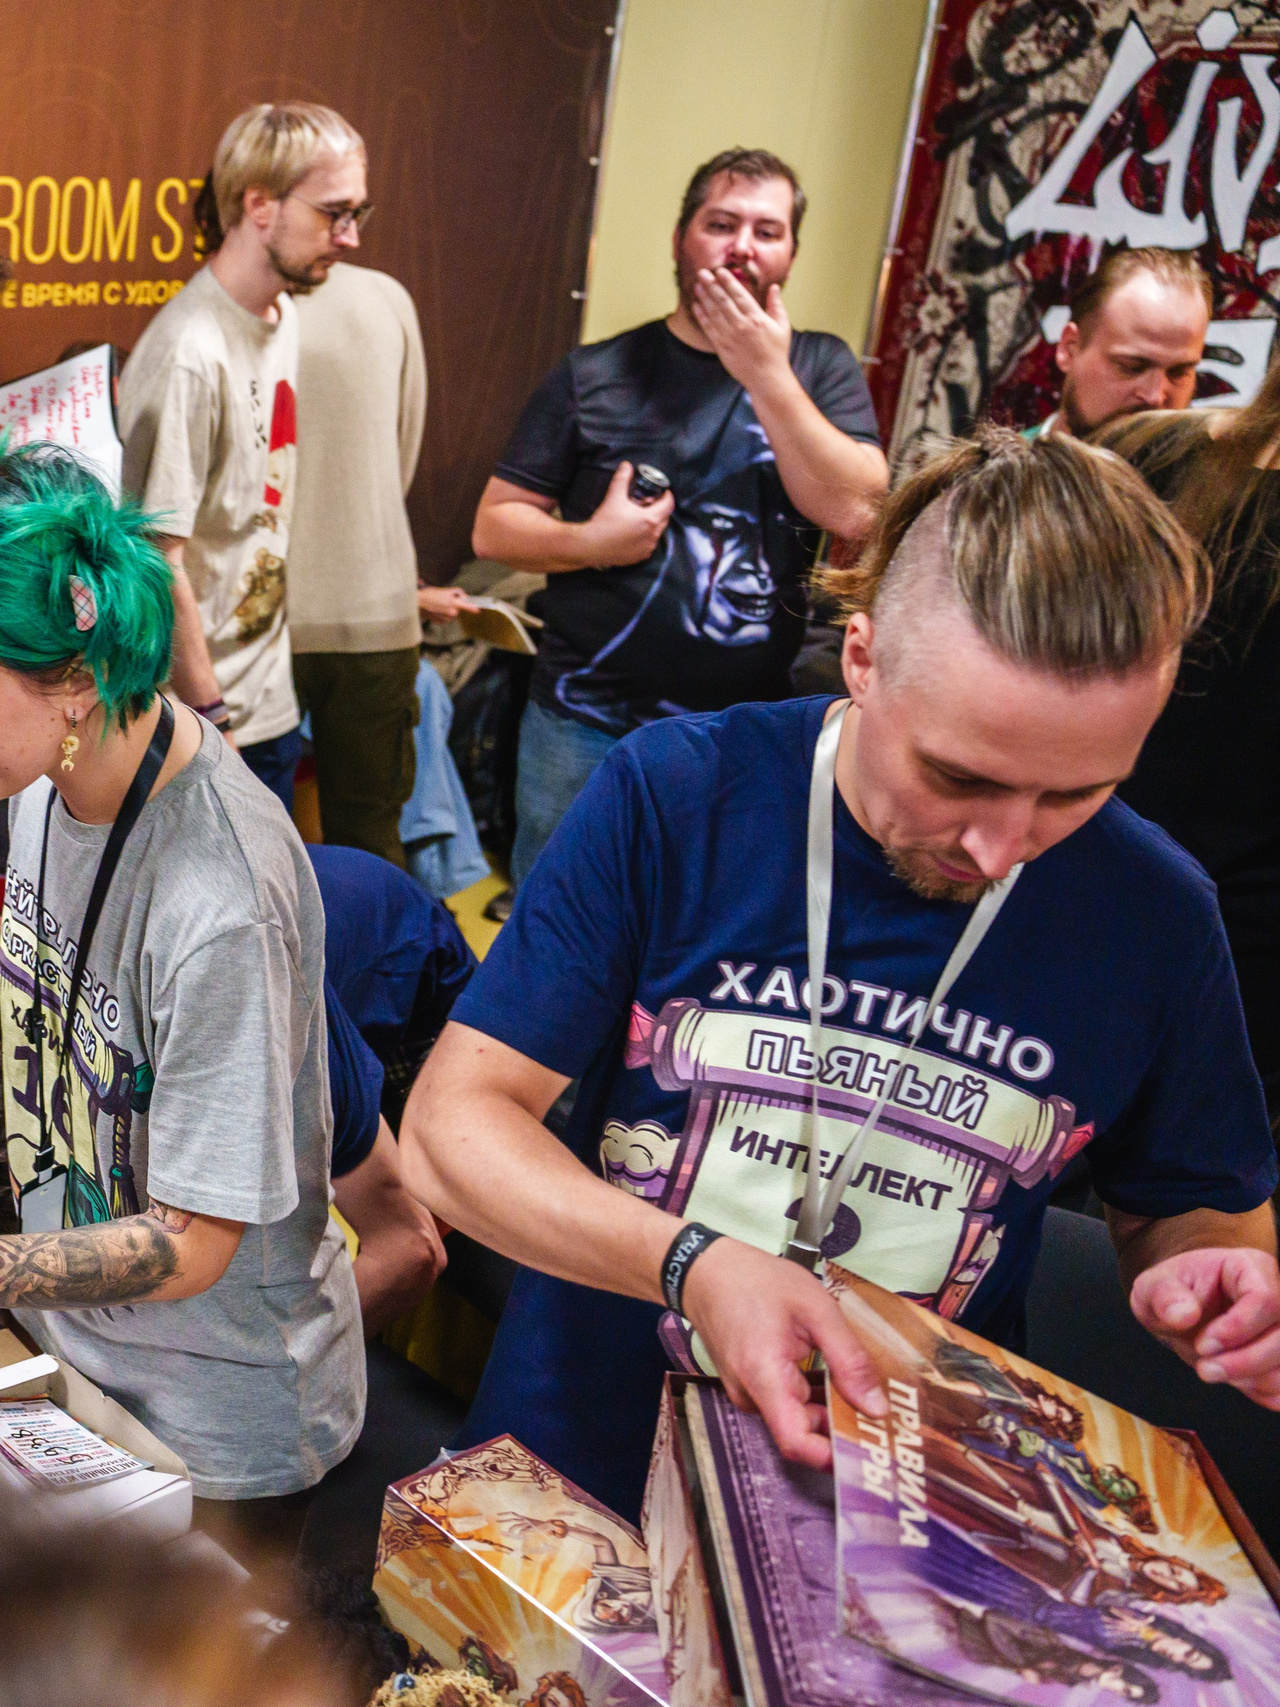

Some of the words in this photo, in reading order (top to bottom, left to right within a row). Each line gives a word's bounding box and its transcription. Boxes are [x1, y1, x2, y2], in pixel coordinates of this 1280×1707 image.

[22, 281, 100, 308] ВРЕМЯ
[709, 960, 1055, 1081] ХАОТИЧНО
[746, 1029, 990, 1130] ПЬЯНЫЙ
[888, 1377, 930, 1549] ПРАВИЛА
